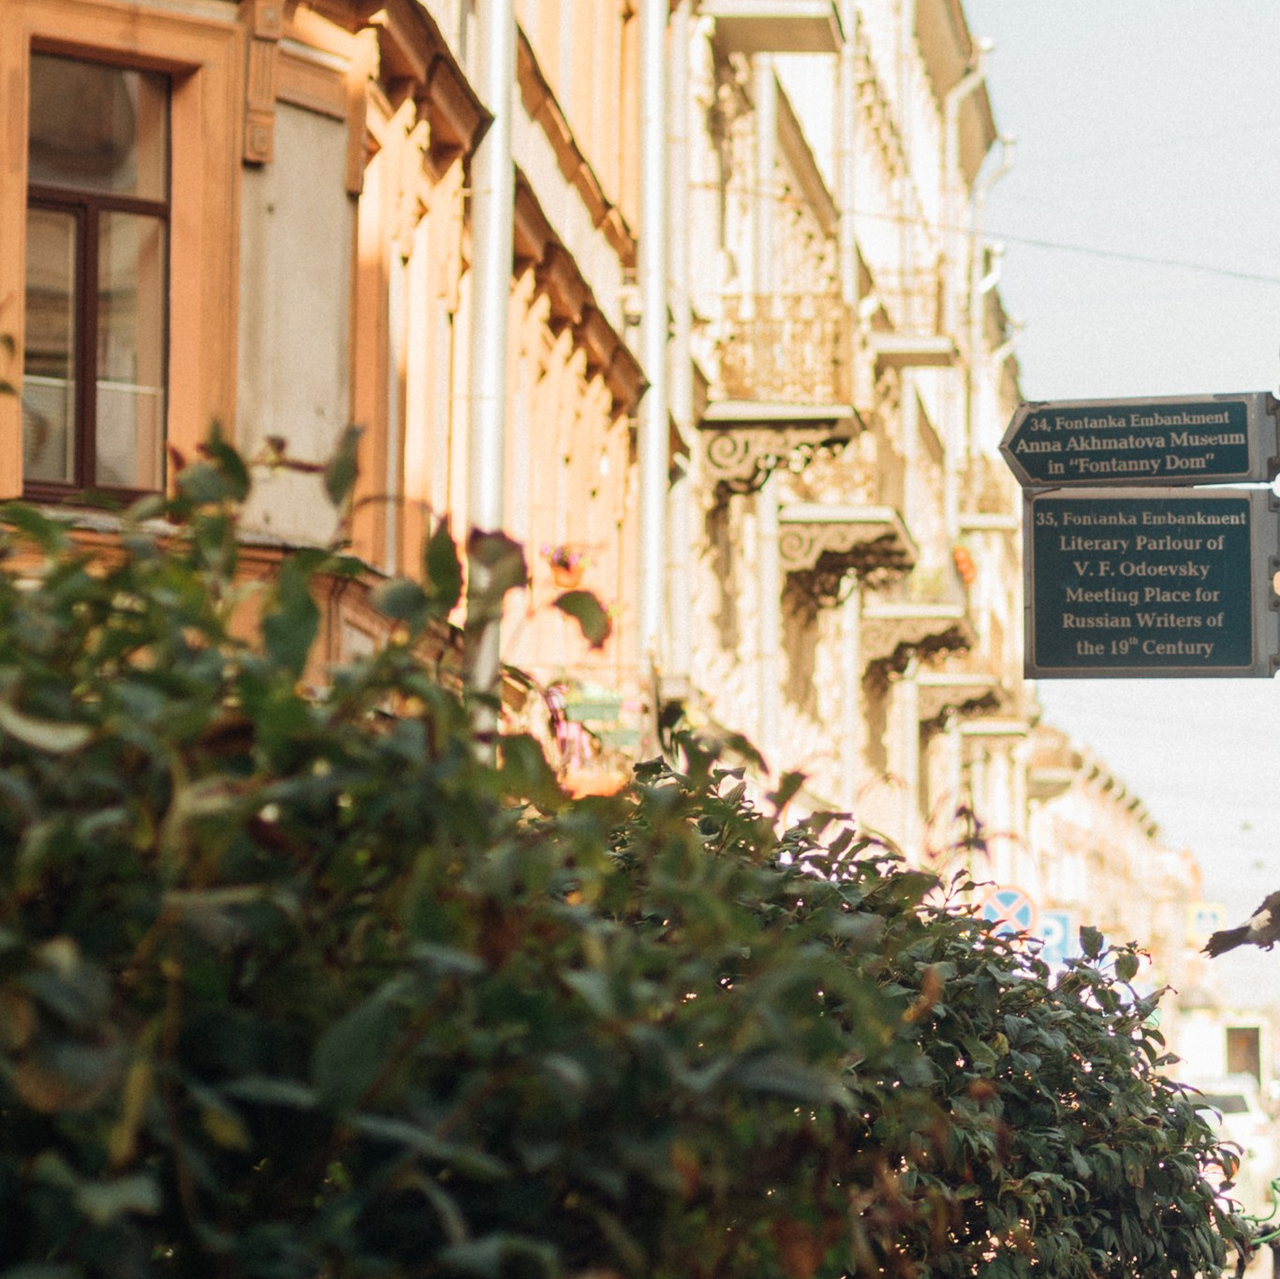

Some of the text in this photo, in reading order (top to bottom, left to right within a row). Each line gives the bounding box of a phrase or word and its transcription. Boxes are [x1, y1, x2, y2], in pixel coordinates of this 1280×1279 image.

[1031, 412, 1229, 432] 34, Fontanka Embankment
[1017, 432, 1244, 453] Anna Akhmatova Museum
[1048, 460, 1064, 474] in
[1038, 512, 1245, 526] 35, Fontanka Embankment
[1060, 535, 1225, 554] Literary Parlour of
[1074, 561, 1210, 580] V. F. Odoevsky
[1066, 587, 1220, 606] Meeting Place for
[1063, 612, 1224, 628] Russian Writers of
[1077, 641, 1104, 654] the
[1143, 640, 1214, 658] Century
